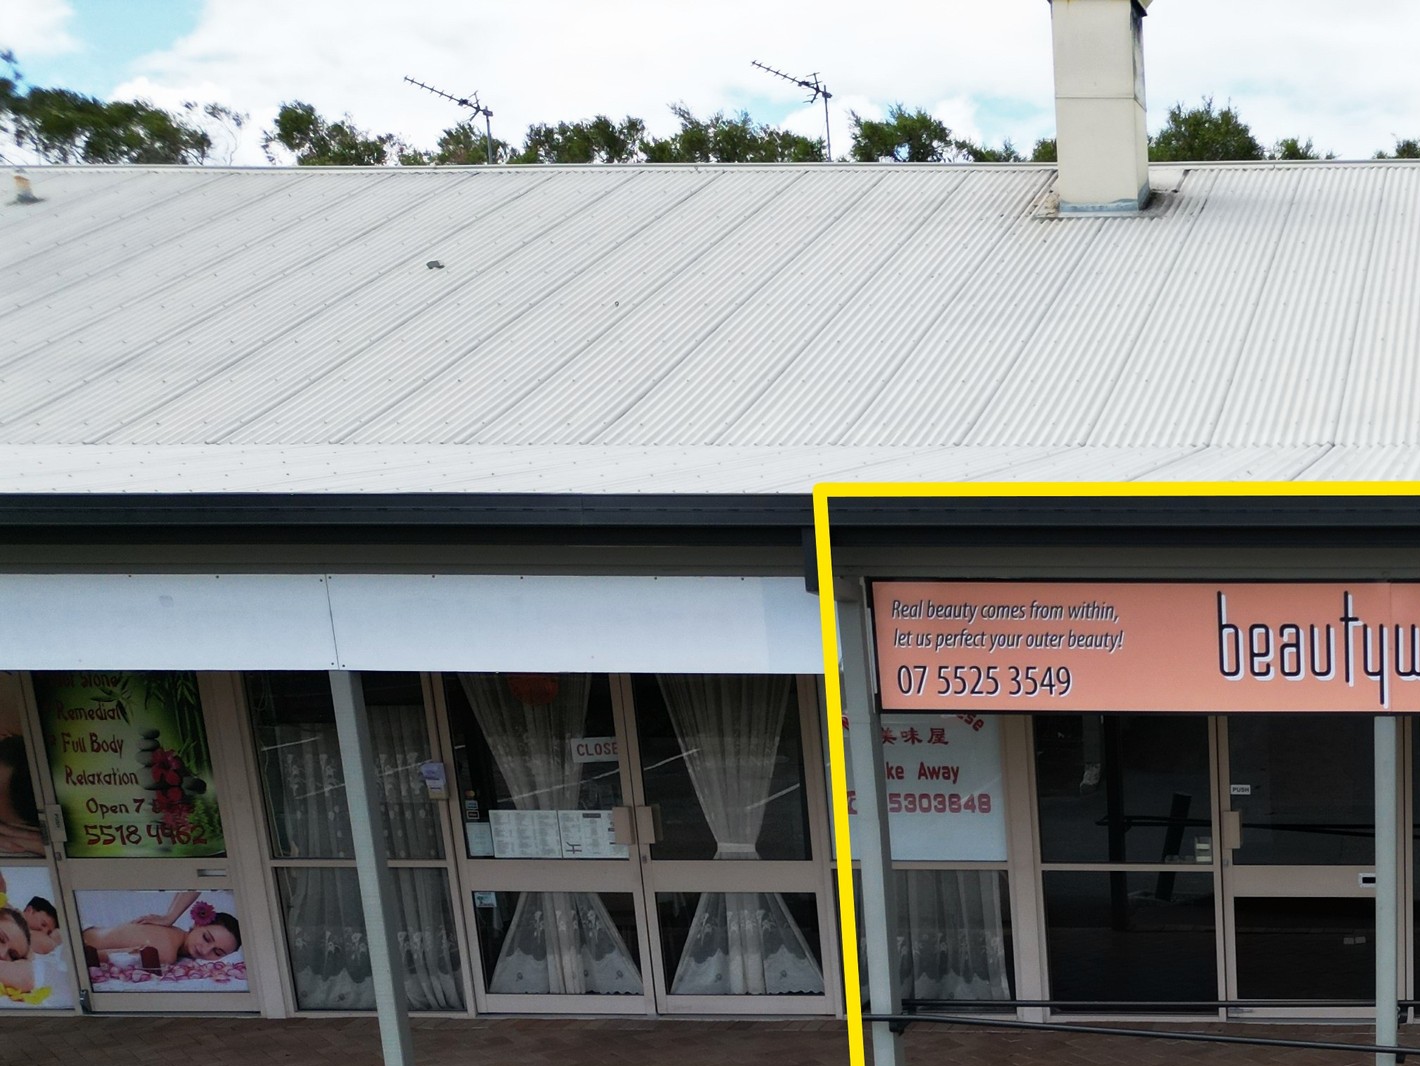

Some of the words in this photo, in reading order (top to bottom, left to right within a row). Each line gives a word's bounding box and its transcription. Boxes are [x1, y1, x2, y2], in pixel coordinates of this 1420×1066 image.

[892, 600, 923, 619] Real
[927, 600, 978, 624] beauty
[981, 603, 1026, 620] comes
[1029, 601, 1064, 620] from
[1068, 601, 1120, 623] within,
[893, 628, 913, 648] let
[916, 632, 932, 648] us
[935, 628, 987, 653] perfect
[989, 632, 1022, 653] your
[1026, 631, 1064, 649] outer
[1068, 629, 1124, 653] beauty!
[897, 664, 928, 696] 07
[937, 665, 1000, 696] 5525
[1008, 665, 1072, 696] 3549
[56, 703, 122, 721] Remedial
[61, 732, 86, 753] Full
[89, 732, 124, 759] Body
[65, 765, 139, 786] Relaxation
[886, 762, 904, 780] ke
[918, 761, 960, 784] Away
[86, 797, 129, 819] Open
[133, 798, 145, 814] 7
[84, 824, 142, 846] 5518
[146, 824, 208, 846] 4962
